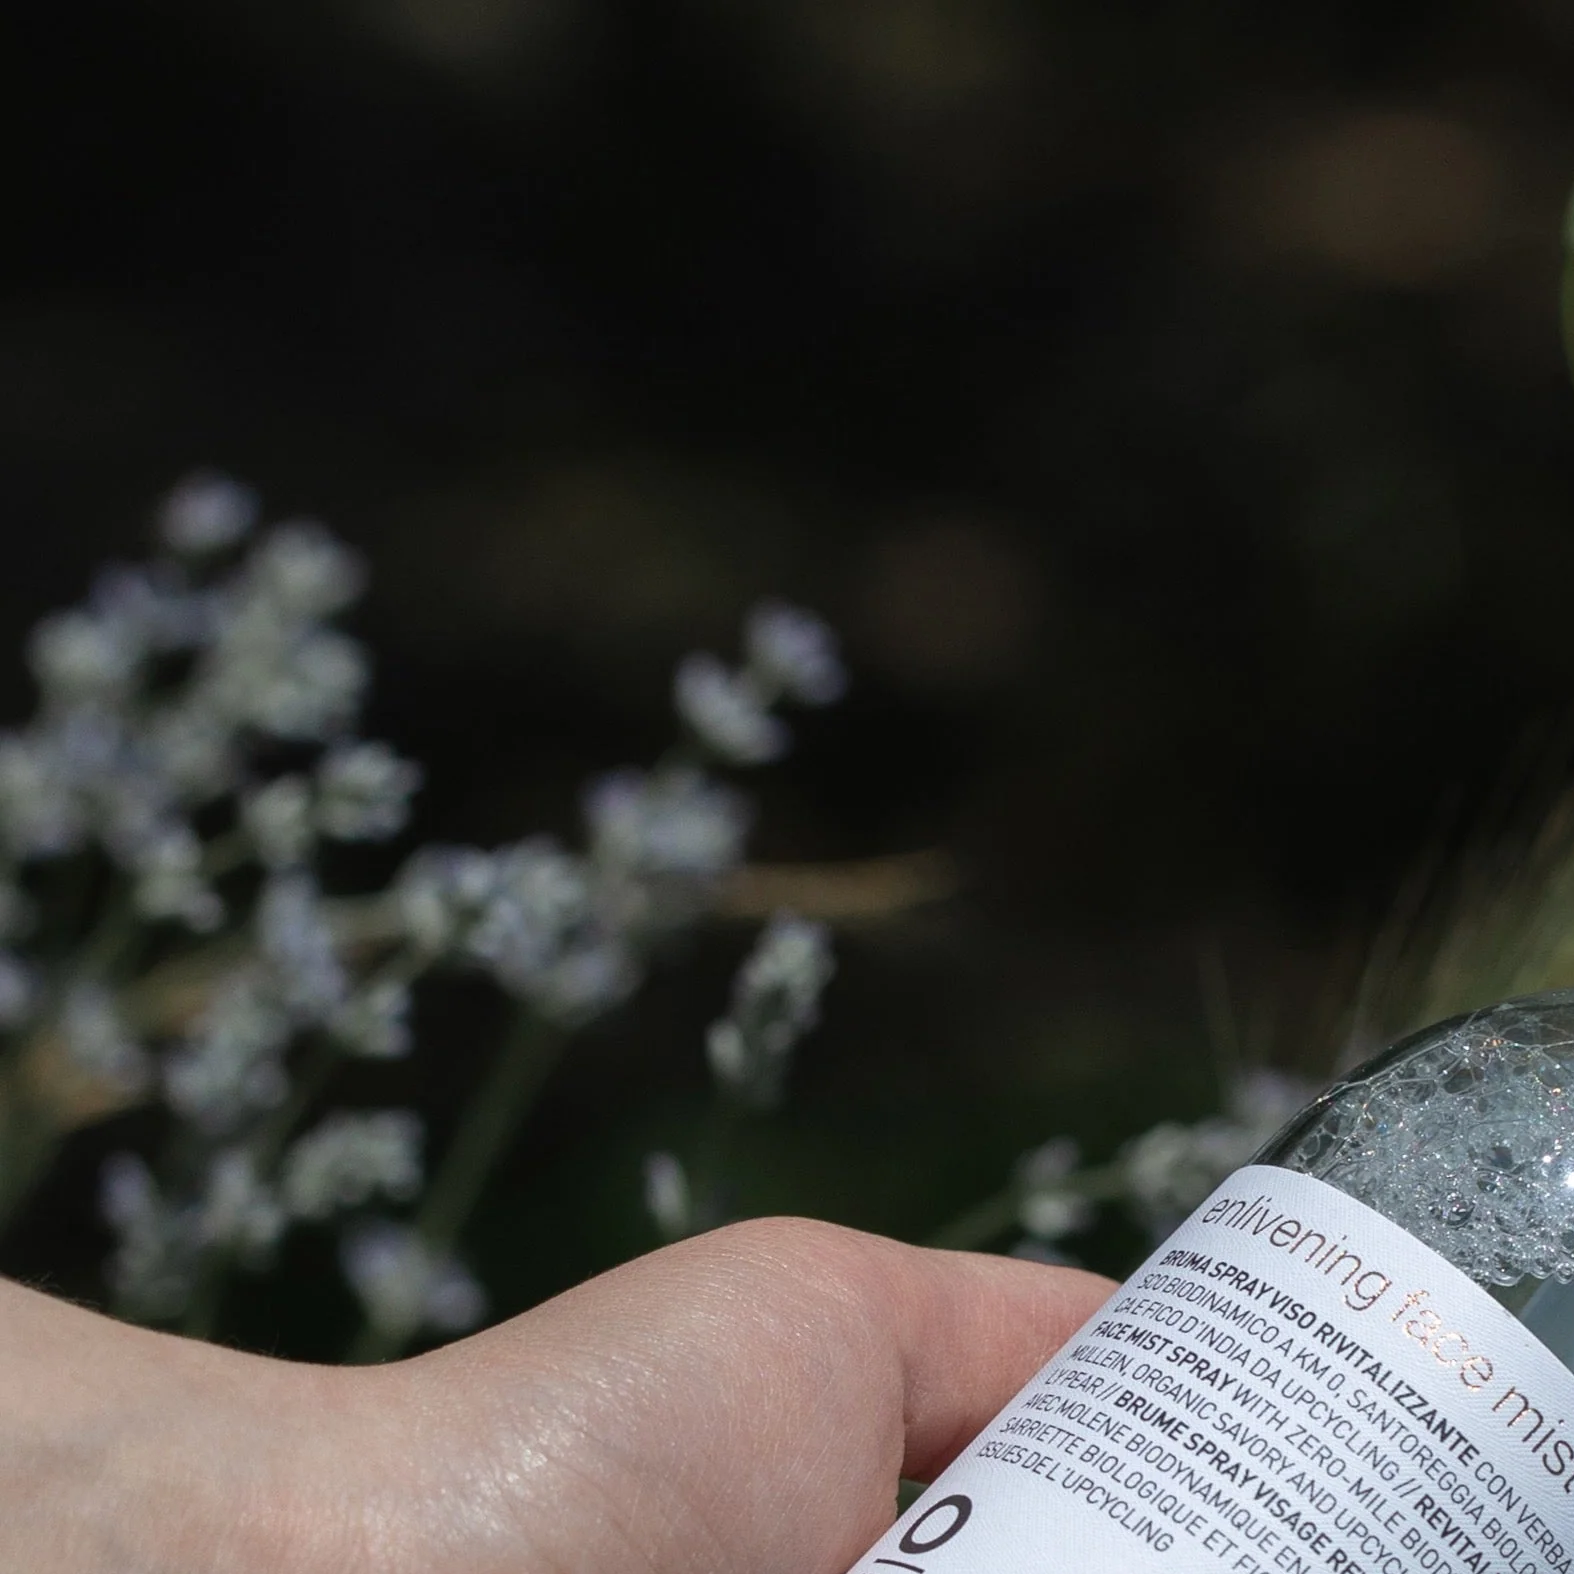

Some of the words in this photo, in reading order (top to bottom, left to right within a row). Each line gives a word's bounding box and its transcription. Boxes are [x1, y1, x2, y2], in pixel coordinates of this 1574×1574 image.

[1159, 1250, 1213, 1274] BRUMA
[1208, 1262, 1274, 1300] SPRAY
[1269, 1290, 1317, 1329] VISO
[1312, 1322, 1480, 1467] RIVITALIZZANTE
[1475, 1462, 1522, 1512] CON
[1202, 1195, 1392, 1311] enlivening
[1392, 1289, 1494, 1392] face
[1021, 1393, 1062, 1412] AVEC
[1056, 1398, 1132, 1443] MOLENE
[1125, 1432, 1281, 1553] BIODYNAMIQUE
[1069, 1345, 1134, 1376] MULLEIN,
[1131, 1363, 1218, 1420] ORGANIC
[1212, 1413, 1296, 1475] SAVORY
[1286, 1472, 1338, 1515] AND
[1090, 1321, 1129, 1340] FACE
[1125, 1329, 1174, 1356] MIST
[1166, 1347, 1237, 1391] SPRAY
[1233, 1384, 1290, 1431] WITH
[1284, 1423, 1408, 1534] ZERO-MILE
[1114, 1297, 1136, 1314] CA
[1131, 1300, 1149, 1317] E
[1144, 1304, 1184, 1327] FICO
[1180, 1315, 1252, 1368] D'INDIA
[1250, 1358, 1283, 1389] DA
[1281, 1378, 1400, 1482] UPCYCLING
[1114, 1390, 1189, 1441] BRUME
[1183, 1433, 1258, 1488] SPRAY
[1253, 1482, 1333, 1555] VISAGE
[1137, 1274, 1172, 1291] SCO
[1165, 1277, 1280, 1343] BIODINAMICO
[1274, 1338, 1294, 1357] A
[1291, 1347, 1332, 1384] KM
[1347, 1389, 1486, 1525] SANTOREGGIA
[976, 1441, 1024, 1464] ISSUES
[1021, 1452, 1050, 1474] DE
[1045, 1461, 1174, 1552] L'UPCYCLING
[999, 1417, 1086, 1455] SARRIETTE
[1080, 1445, 1208, 1536] BIOLOGIQUE
[1202, 1529, 1238, 1559] ET
